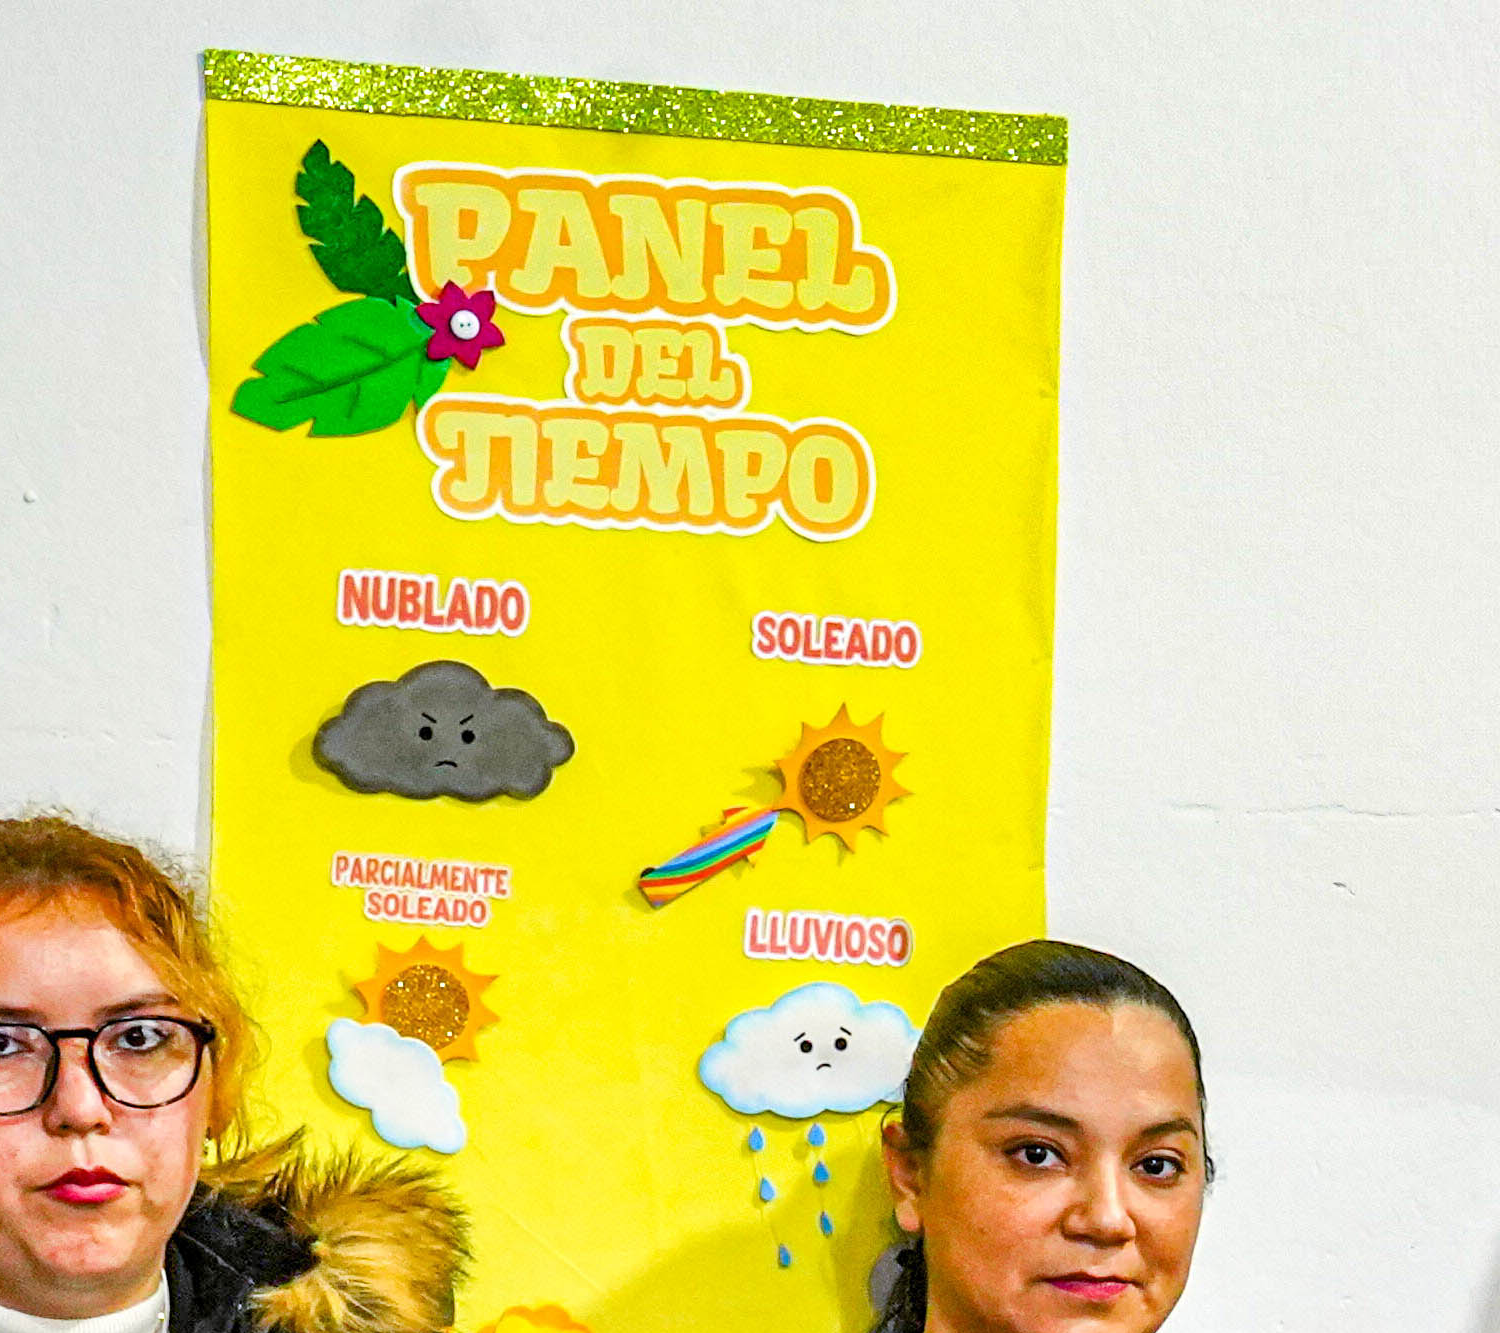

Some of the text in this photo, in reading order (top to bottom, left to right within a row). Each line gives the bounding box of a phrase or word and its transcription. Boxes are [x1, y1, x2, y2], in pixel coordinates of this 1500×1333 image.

[415, 182, 876, 313] PANEL
[575, 325, 737, 400] DEL
[434, 409, 859, 524] TIEMPO
[342, 574, 525, 631] NUBLADO
[756, 615, 918, 663] SOLEADO
[334, 855, 508, 896] PARCIALMENTE
[367, 891, 487, 924] SOLEADO
[748, 914, 910, 962] LLUVIOSO
